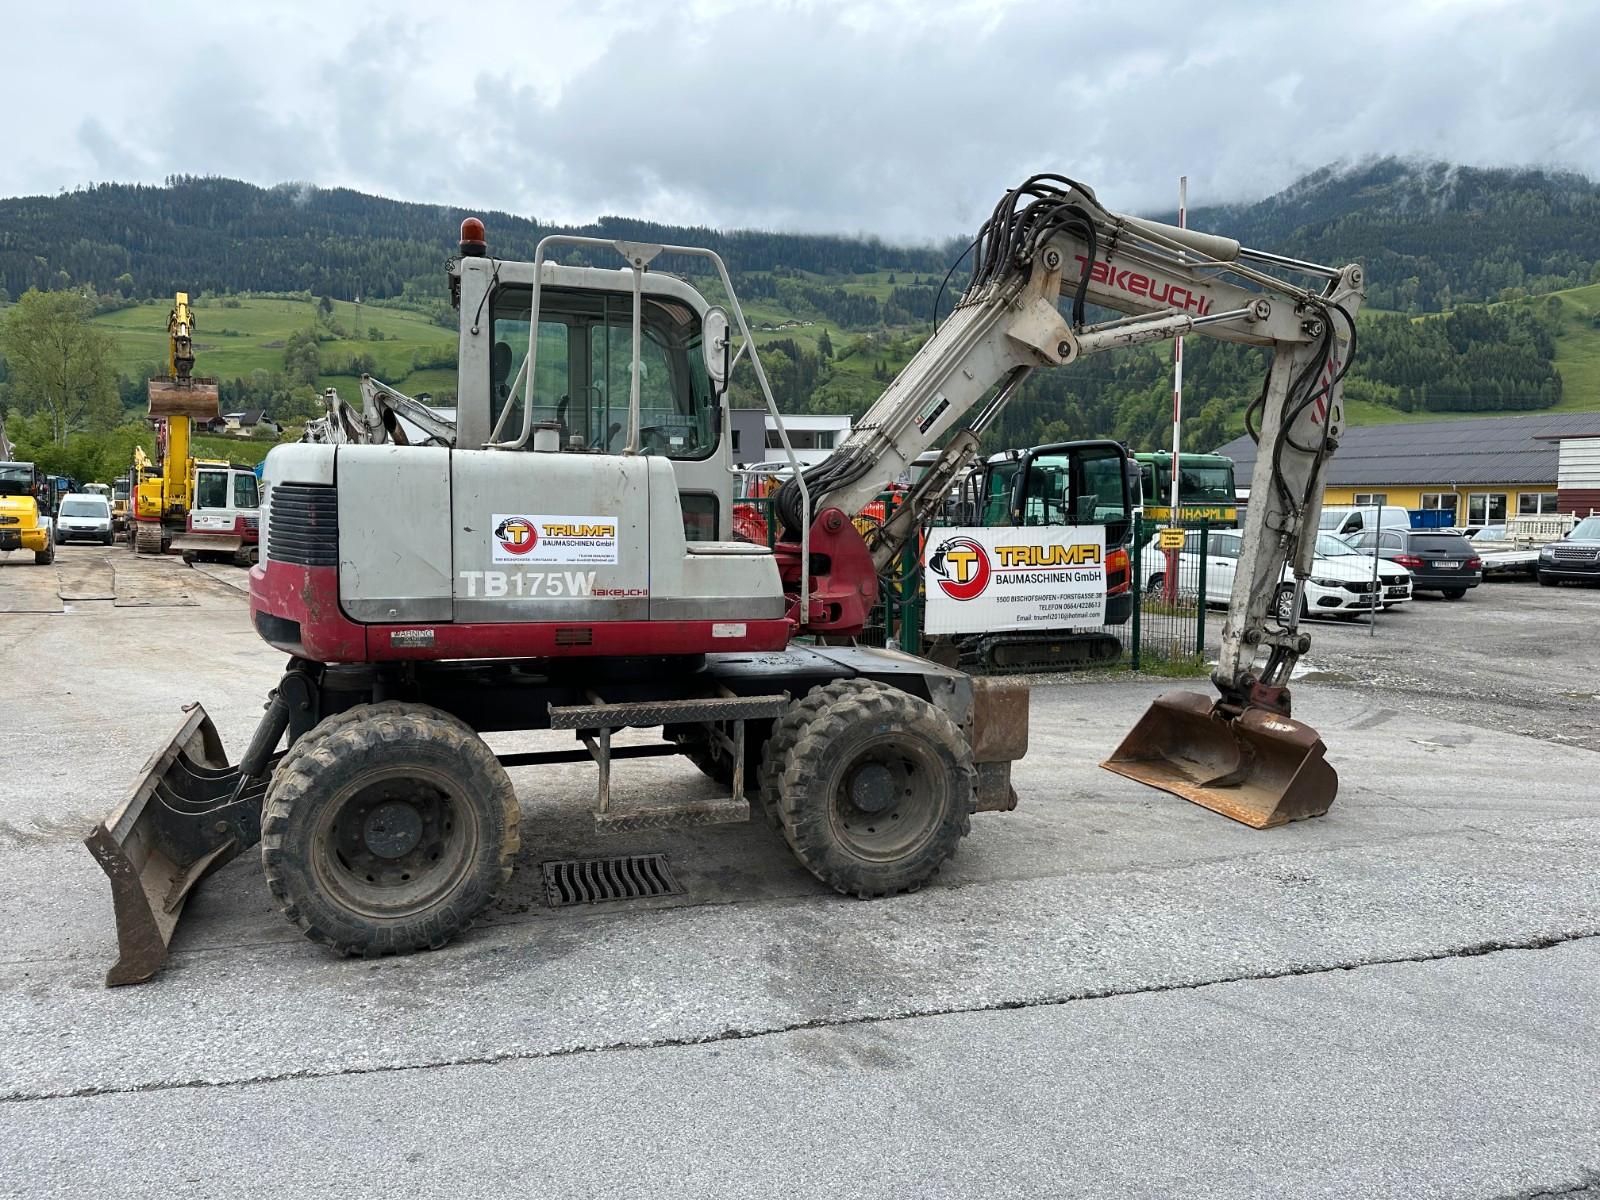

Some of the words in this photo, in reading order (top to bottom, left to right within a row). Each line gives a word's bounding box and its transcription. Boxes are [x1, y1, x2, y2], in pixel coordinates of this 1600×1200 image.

[542, 524, 615, 538] TRIUMFI
[995, 544, 1101, 567] TRIUMFI
[947, 551, 978, 582] T
[459, 570, 597, 598] TB175W
[995, 573, 1072, 585] BAUMASCHINEN
[1074, 571, 1102, 583] GmbH
[1010, 594, 1057, 603] BISCHOFSHOFEN
[1060, 593, 1094, 601] FORSTGASSE
[1039, 603, 1062, 611] TELEFON
